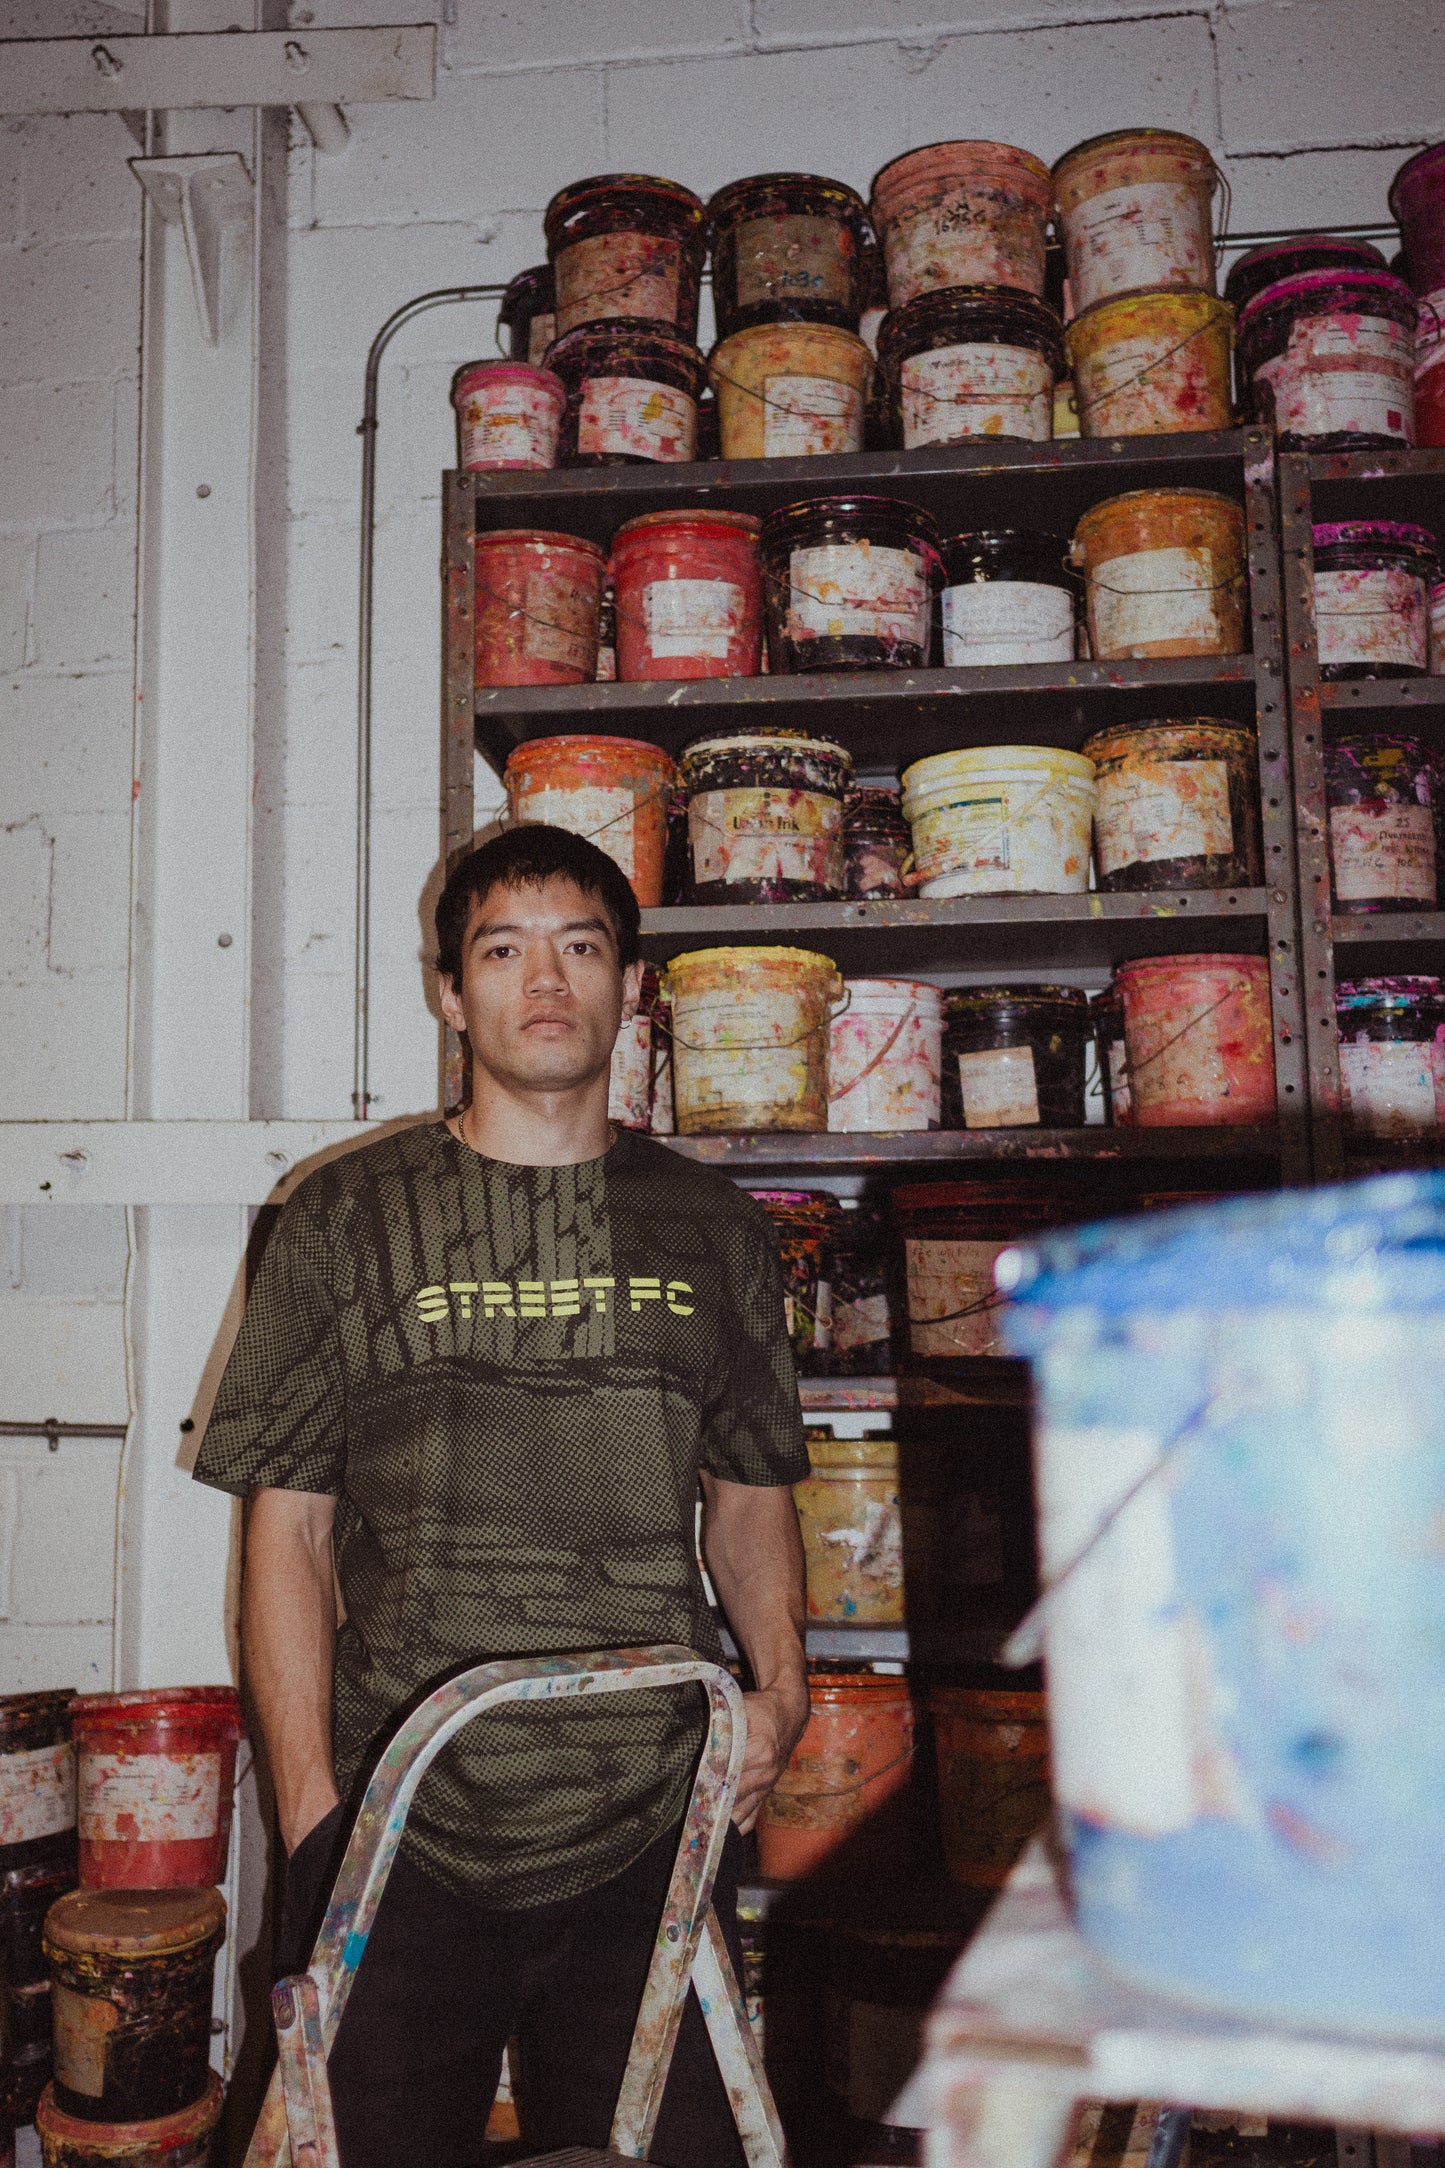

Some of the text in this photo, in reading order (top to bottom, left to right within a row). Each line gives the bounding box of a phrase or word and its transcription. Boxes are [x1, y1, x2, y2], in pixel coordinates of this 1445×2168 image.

[777, 815, 801, 831] Ink
[416, 1277, 695, 1323] STREET FC
